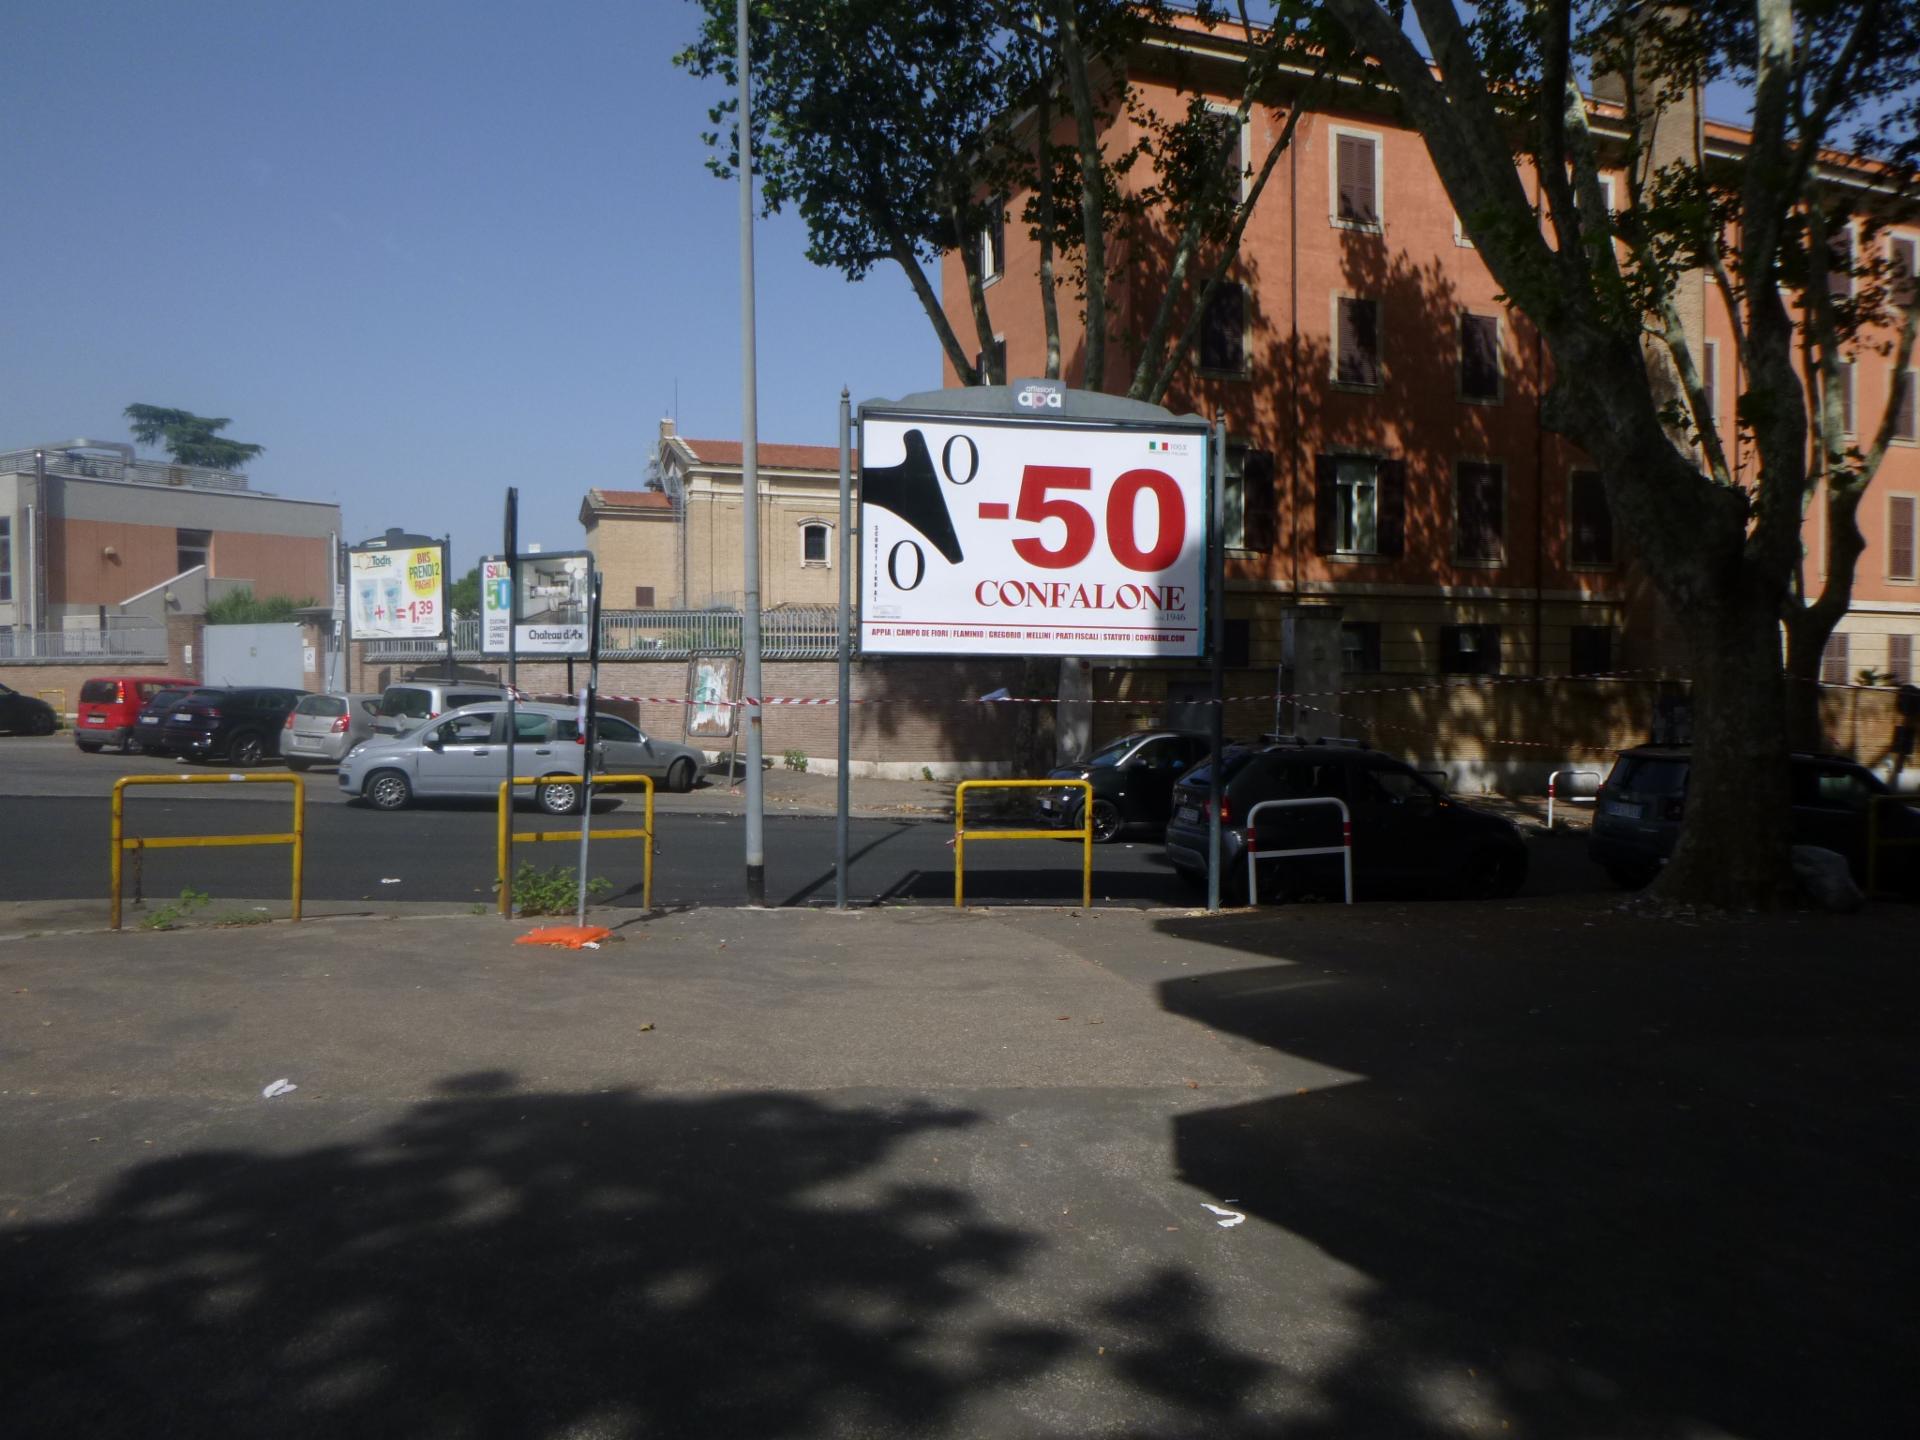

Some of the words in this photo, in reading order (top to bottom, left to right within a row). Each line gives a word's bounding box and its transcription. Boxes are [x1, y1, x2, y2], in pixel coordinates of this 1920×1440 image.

[409, 564, 434, 580] PRENDI
[434, 562, 441, 576] 2
[486, 579, 512, 610] 50
[975, 580, 1186, 611] CONFALONE
[1166, 613, 1186, 621] 1946
[528, 629, 562, 640] Chateau
[872, 628, 891, 636] APPIA
[896, 629, 920, 637] CAMPO
[953, 630, 983, 638] FLAMINIO
[988, 631, 1021, 639] GREGORIO
[1056, 632, 1073, 640] PRATI
[1103, 633, 1131, 641] STATUTO
[1135, 634, 1185, 642] CONFALONE.COM
